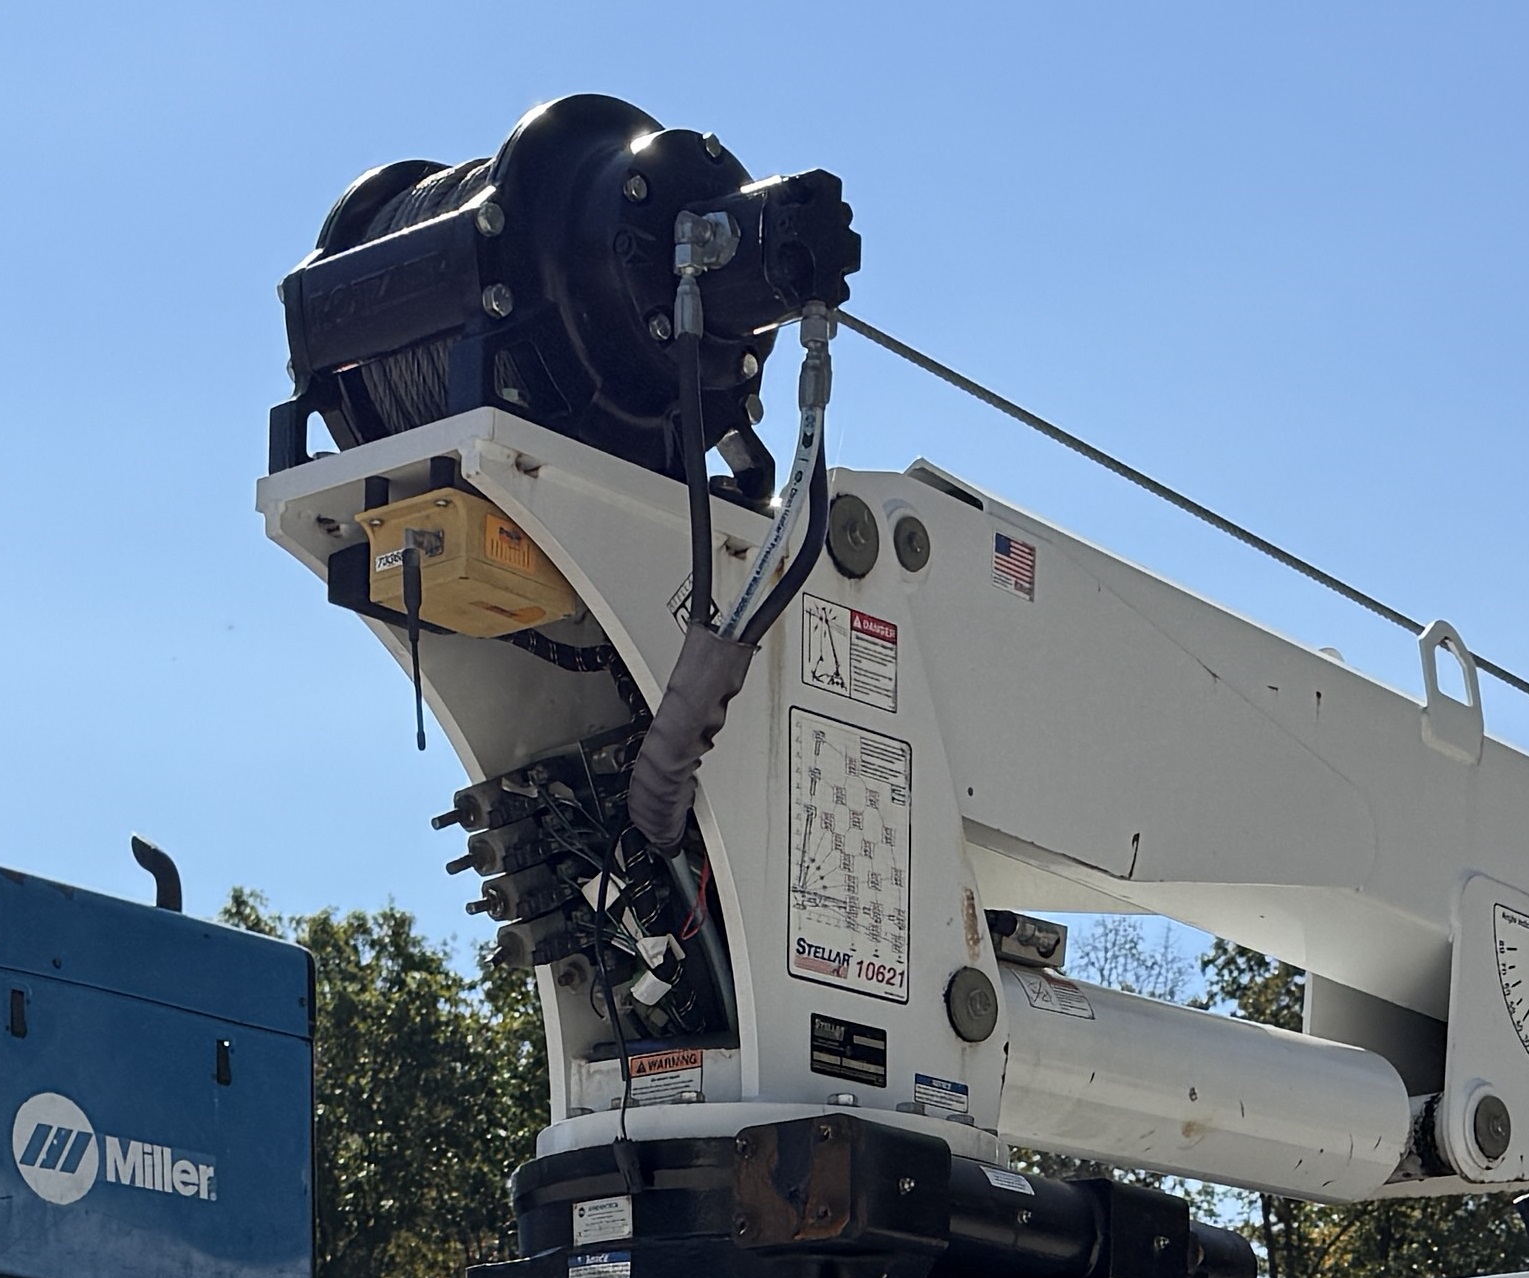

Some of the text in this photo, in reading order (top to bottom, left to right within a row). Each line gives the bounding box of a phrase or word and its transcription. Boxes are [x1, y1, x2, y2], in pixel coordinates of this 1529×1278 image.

[862, 619, 896, 638] DANGER
[795, 937, 906, 989] STELLAR 10621
[647, 1053, 698, 1072] WARNING
[105, 1135, 214, 1200] Miller
